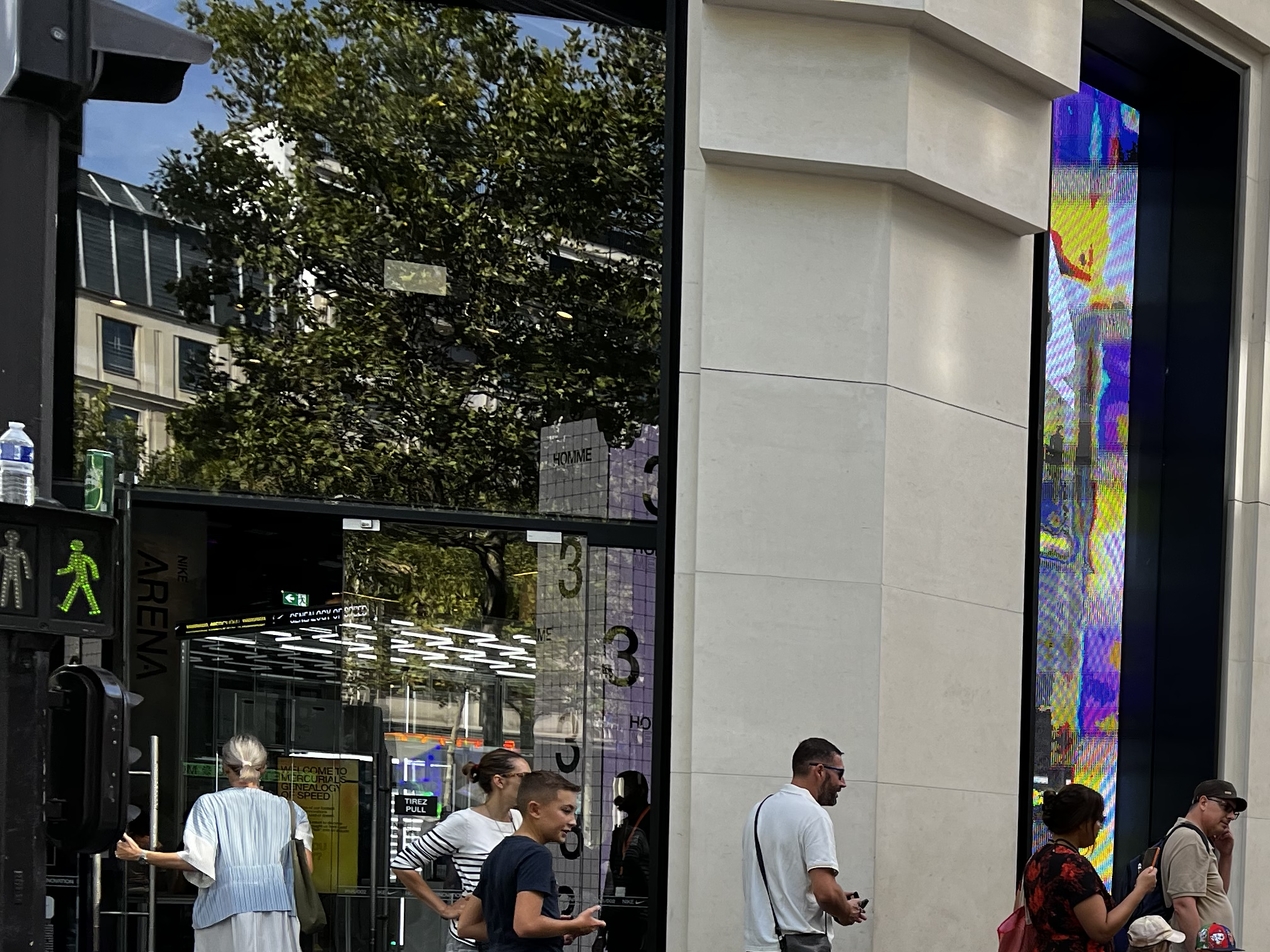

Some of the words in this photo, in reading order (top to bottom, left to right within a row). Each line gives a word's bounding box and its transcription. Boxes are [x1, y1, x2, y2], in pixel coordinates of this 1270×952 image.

[553, 447, 592, 466] HOMME
[177, 555, 189, 584] NIKE
[136, 549, 169, 681] ARENA
[602, 625, 640, 687] 3
[280, 766, 334, 776] WELCOME
[335, 767, 347, 776] TO
[280, 775, 347, 784] MERCURIALS
[281, 784, 341, 792] GENEALOGY
[297, 792, 331, 801] SPEED
[404, 797, 428, 806] TIREZ
[405, 805, 427, 814] PULL
